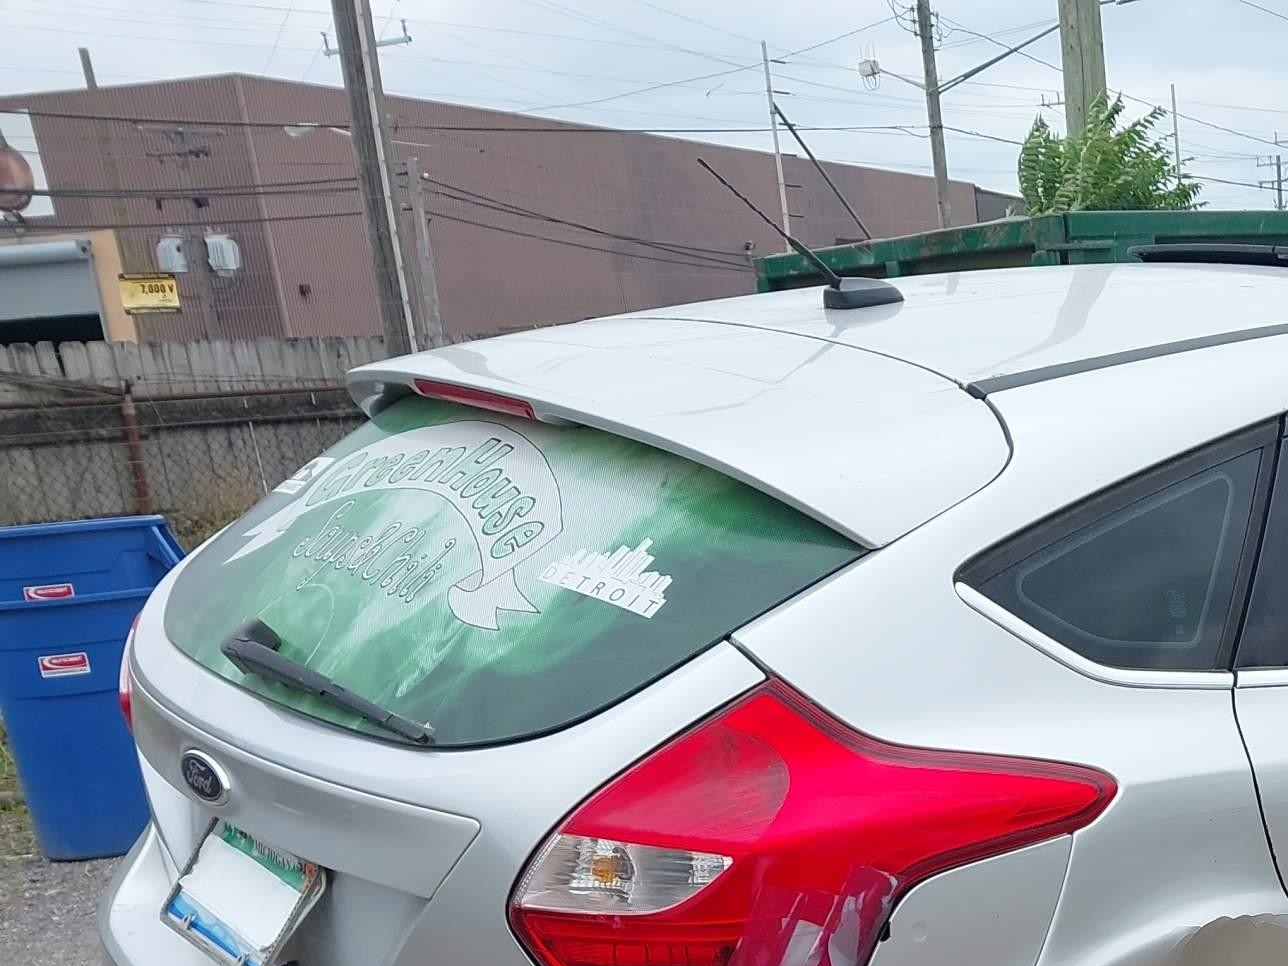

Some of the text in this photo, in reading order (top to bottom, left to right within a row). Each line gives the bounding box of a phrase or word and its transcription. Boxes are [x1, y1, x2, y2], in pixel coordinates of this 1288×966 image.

[140, 284, 166, 295] 7,000
[542, 566, 660, 614] DETROIT
[186, 759, 213, 794] Ford
